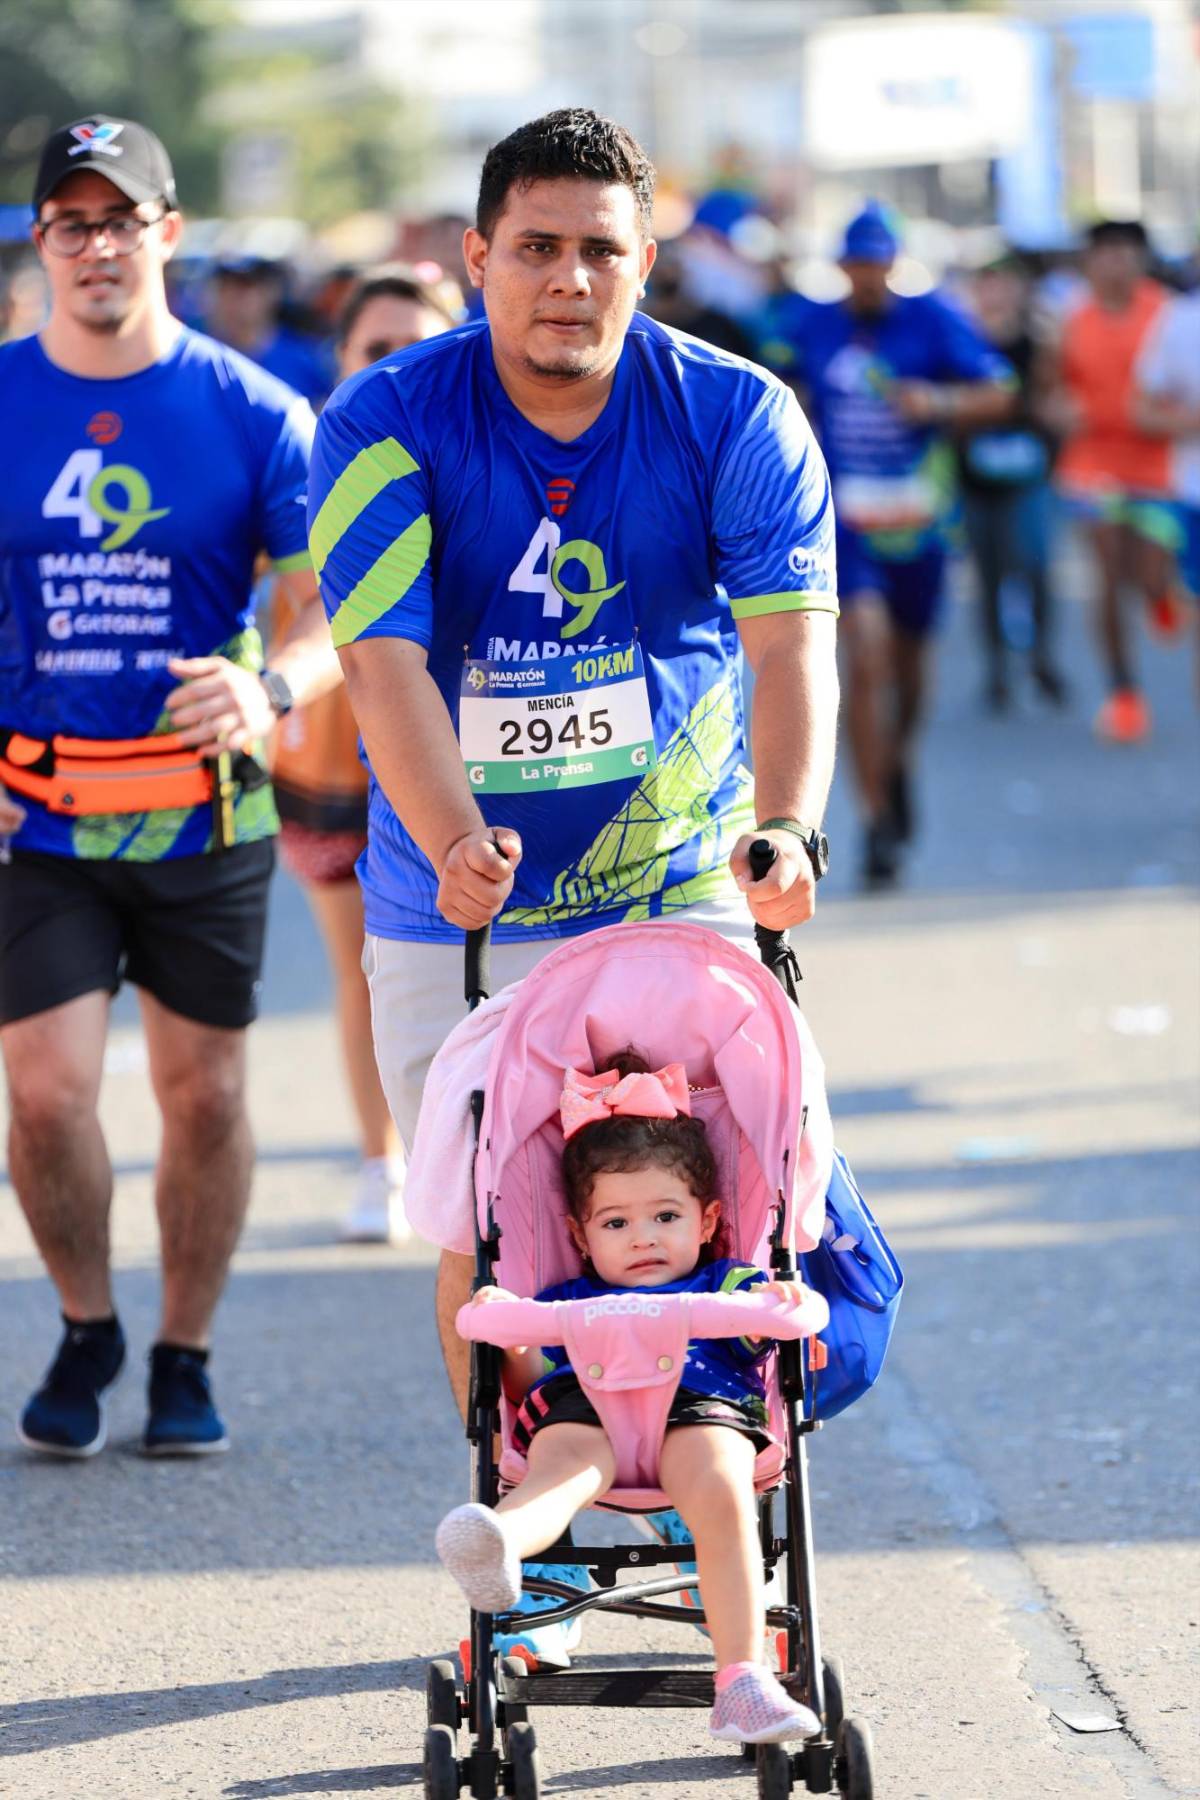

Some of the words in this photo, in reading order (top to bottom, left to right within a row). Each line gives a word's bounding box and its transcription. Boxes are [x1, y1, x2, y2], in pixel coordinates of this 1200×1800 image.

[42, 449, 171, 551] 49
[508, 516, 626, 639] 49
[41, 580, 80, 608] La
[486, 637, 495, 661] MEDIA
[466, 667, 488, 691] 49
[489, 667, 545, 682] MARATÓN
[571, 649, 635, 684] 10KM
[527, 695, 575, 712] MENCÍA
[499, 708, 613, 756] 2945
[521, 767, 541, 780] La
[543, 761, 594, 778] Prensa
[583, 1300, 661, 1327] piccolo
